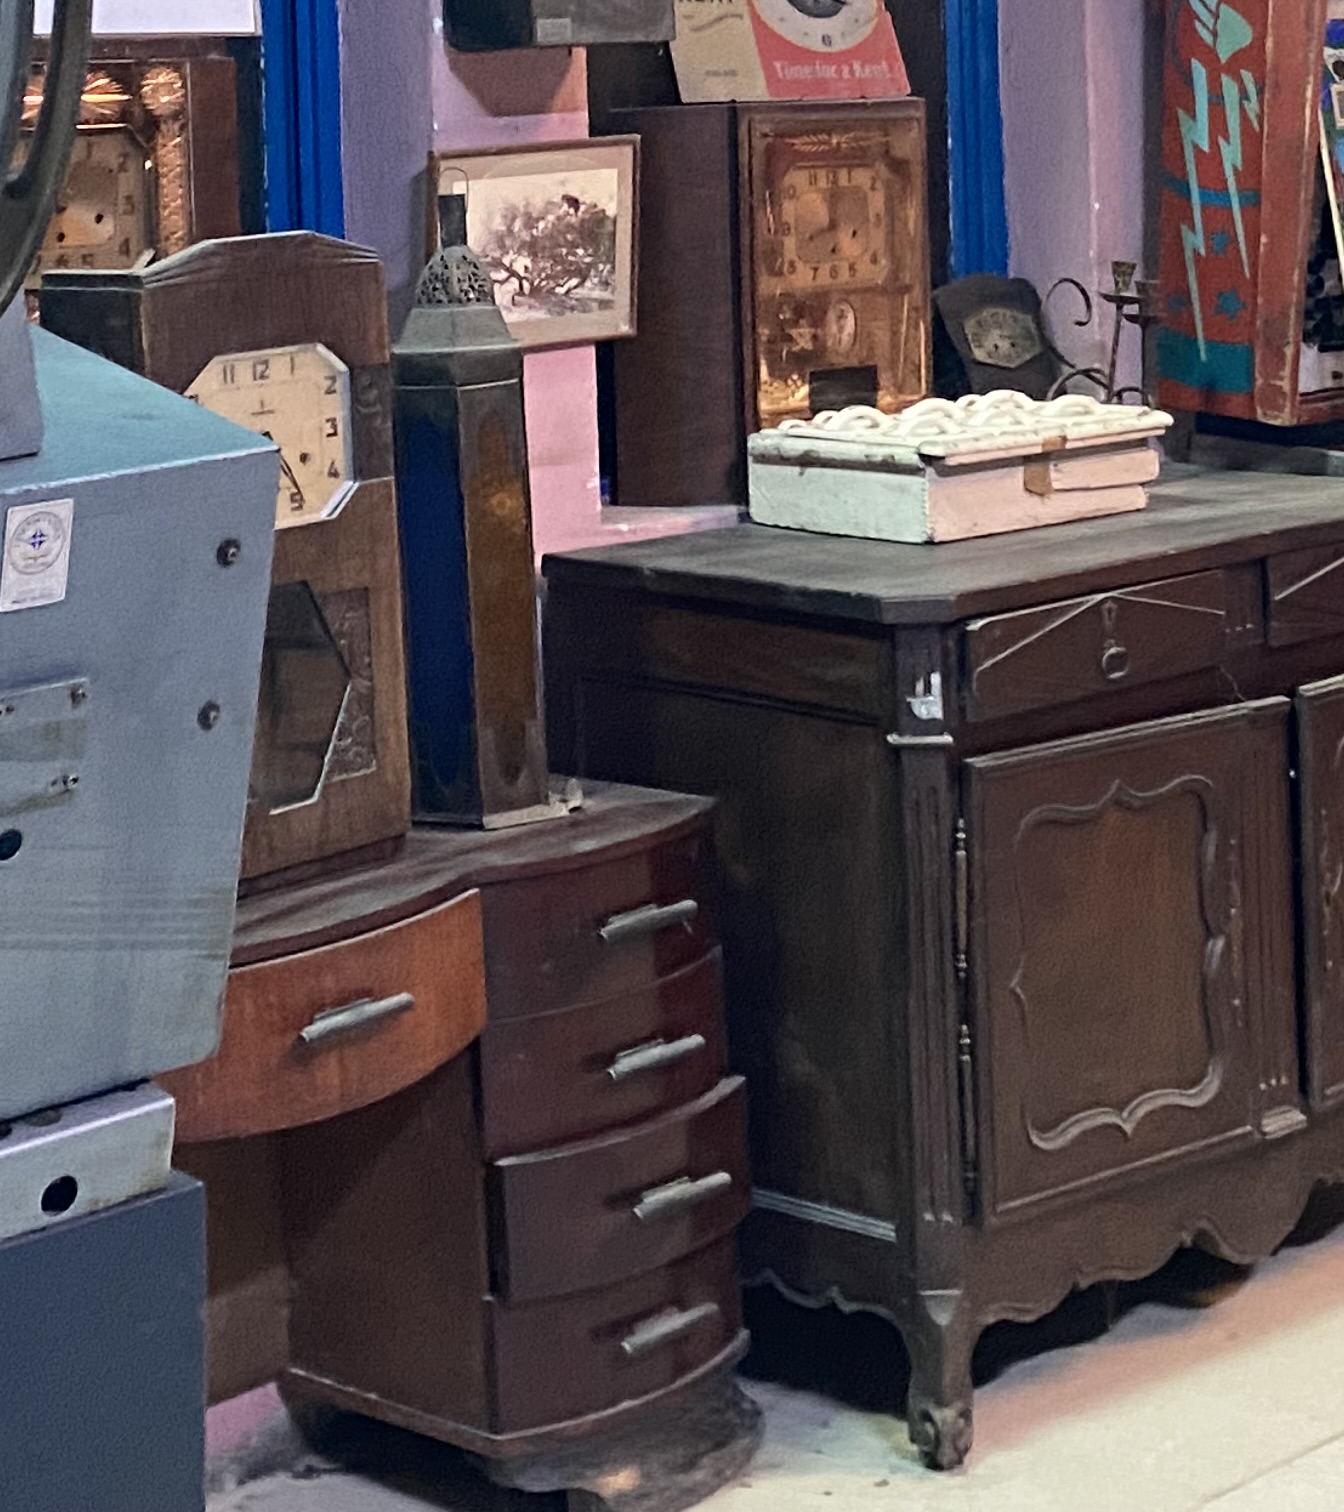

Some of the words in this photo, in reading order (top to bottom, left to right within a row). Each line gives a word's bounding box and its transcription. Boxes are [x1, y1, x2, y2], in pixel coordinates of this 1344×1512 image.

[252, 358, 270, 381] 12
[324, 375, 337, 395] 2
[325, 417, 338, 438] 3
[327, 460, 340, 479] 4
